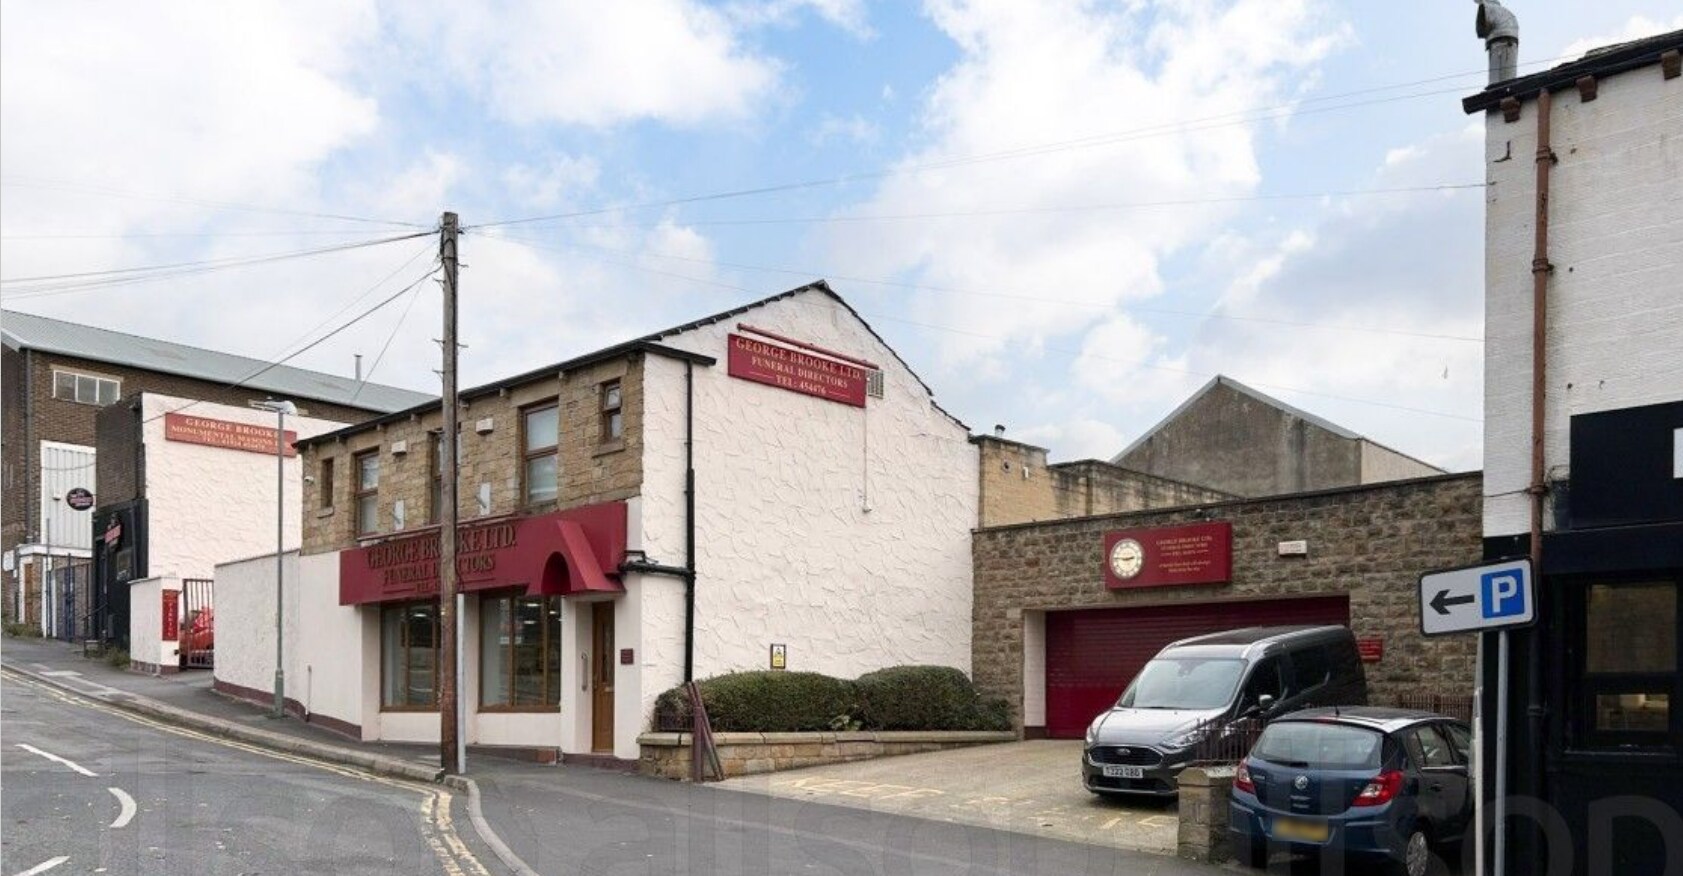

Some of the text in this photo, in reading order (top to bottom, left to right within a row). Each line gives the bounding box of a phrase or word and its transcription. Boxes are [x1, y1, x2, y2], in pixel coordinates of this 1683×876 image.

[736, 338, 861, 381] GEORGE BROOKE LTD.
[752, 356, 848, 389] FUNERAL DIRECTORS
[171, 425, 235, 440] MONUMENTAL
[185, 418, 232, 431] GEORGE
[367, 539, 421, 568] GEORGE
[483, 524, 518, 551] LTD.
[384, 562, 428, 584] FUNERAL
[1492, 575, 1517, 613] P
